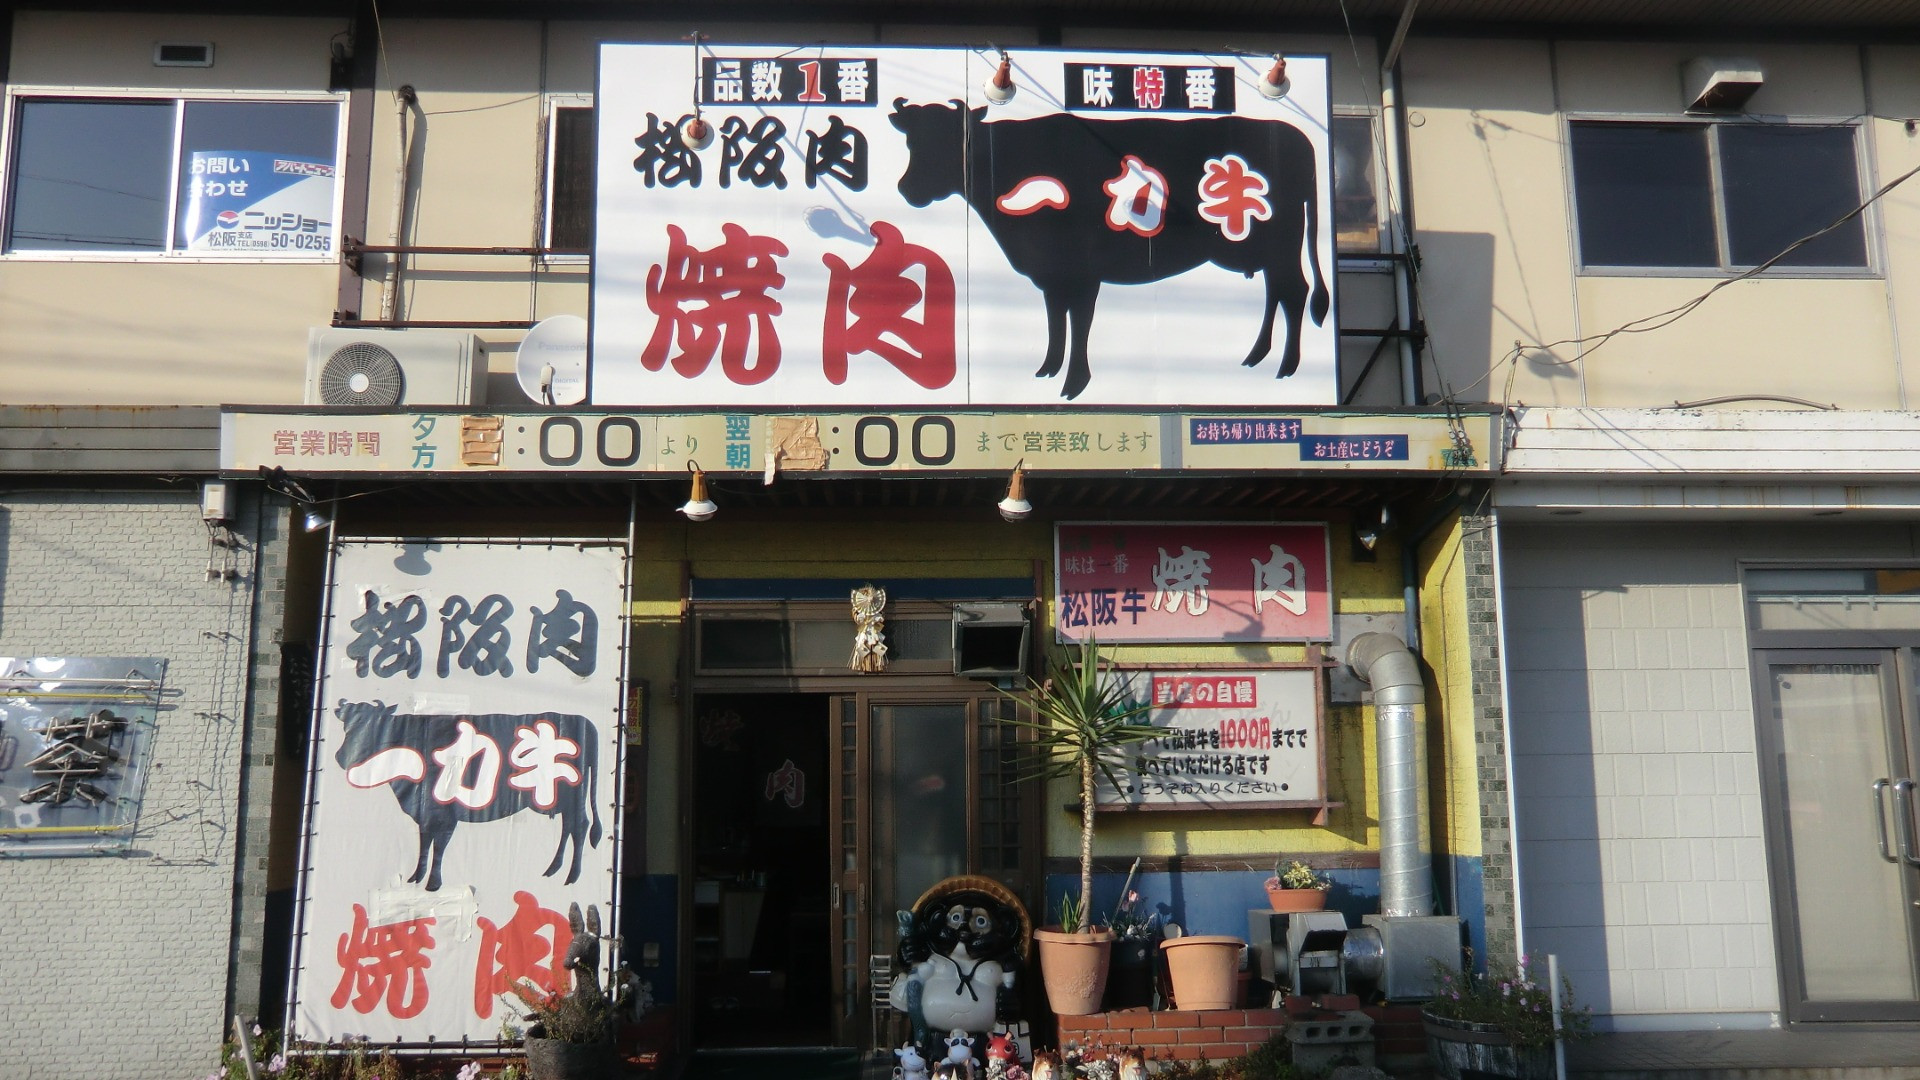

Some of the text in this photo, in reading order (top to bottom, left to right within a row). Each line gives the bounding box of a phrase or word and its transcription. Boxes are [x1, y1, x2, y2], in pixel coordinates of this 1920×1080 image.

[714, 60, 869, 102] 品数1番
[1083, 66, 1216, 109] 味特番
[996, 154, 1273, 242] 一力牛
[208, 232, 236, 247] 松阪
[244, 211, 331, 232] ニッショー
[641, 221, 957, 390] 焼肉
[1196, 422, 1300, 441] お持ち帰り出来ます
[1314, 440, 1395, 459] お土産にどうぞ
[1151, 544, 1307, 615] 焼肉
[1061, 588, 1147, 628] 松阪牛
[345, 589, 599, 679] 松阪肉
[347, 719, 582, 810] 一力牛
